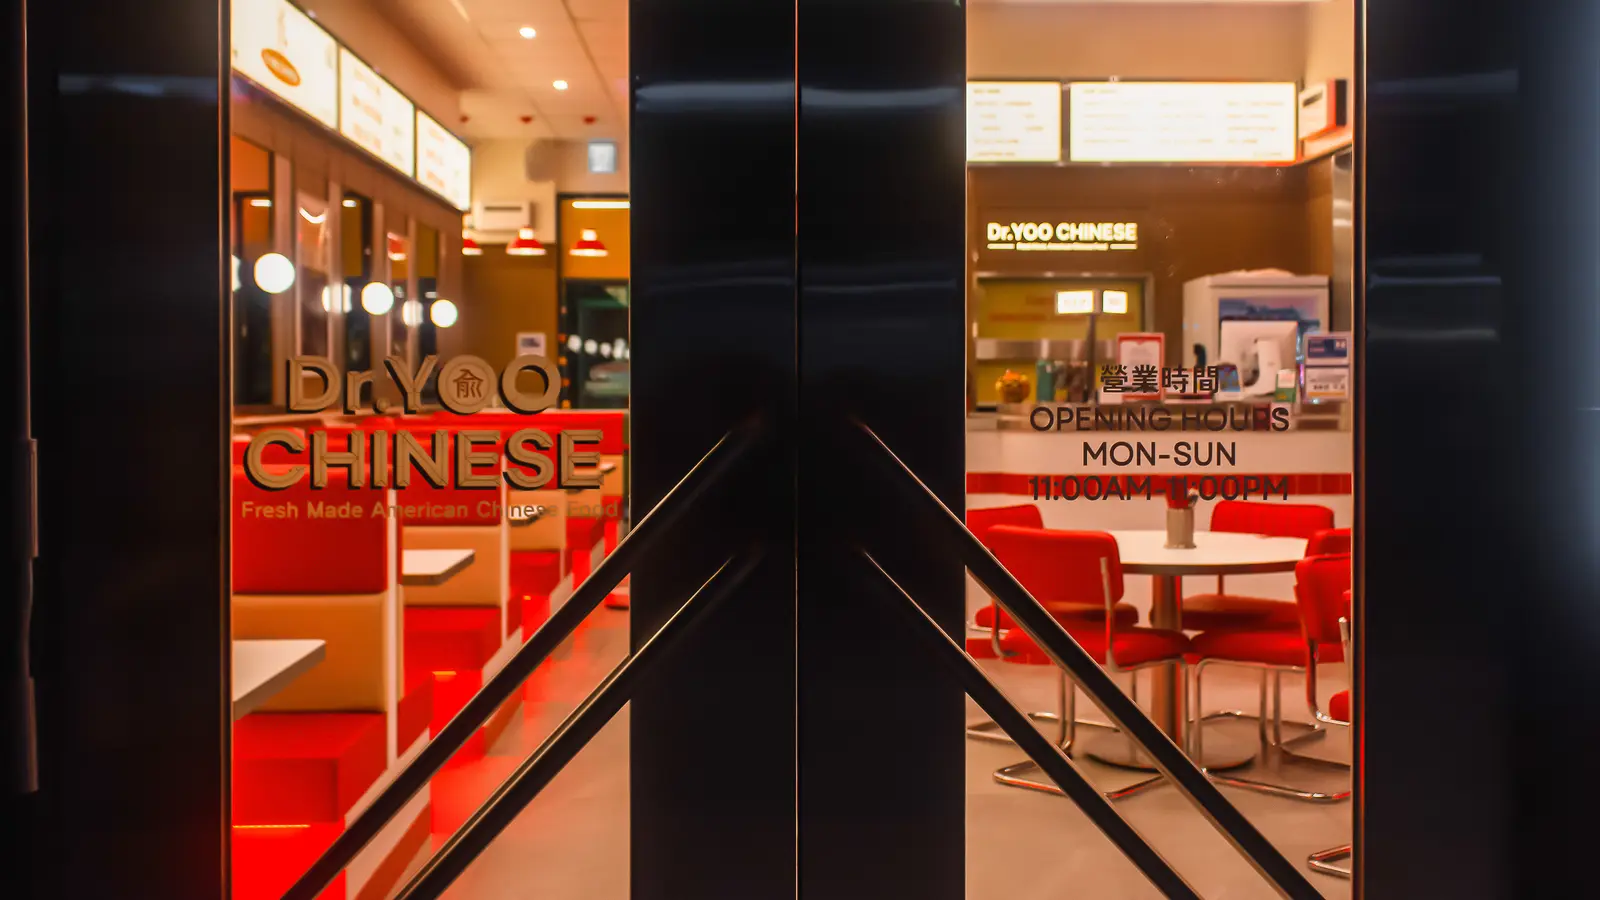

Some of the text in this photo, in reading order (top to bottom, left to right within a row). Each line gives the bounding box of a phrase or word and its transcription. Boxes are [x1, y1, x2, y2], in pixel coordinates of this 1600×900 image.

[987, 222, 1138, 242] Dr.YOO CHINESE
[287, 354, 561, 415] Dr.YOO
[1101, 365, 1219, 394] 營業時間
[1030, 407, 1290, 432] OPENING HOURS
[244, 428, 604, 491] CHINESE
[1082, 441, 1236, 466] MON-SUN
[242, 501, 298, 519] Fresh
[307, 501, 363, 519] Made
[371, 501, 468, 519] American
